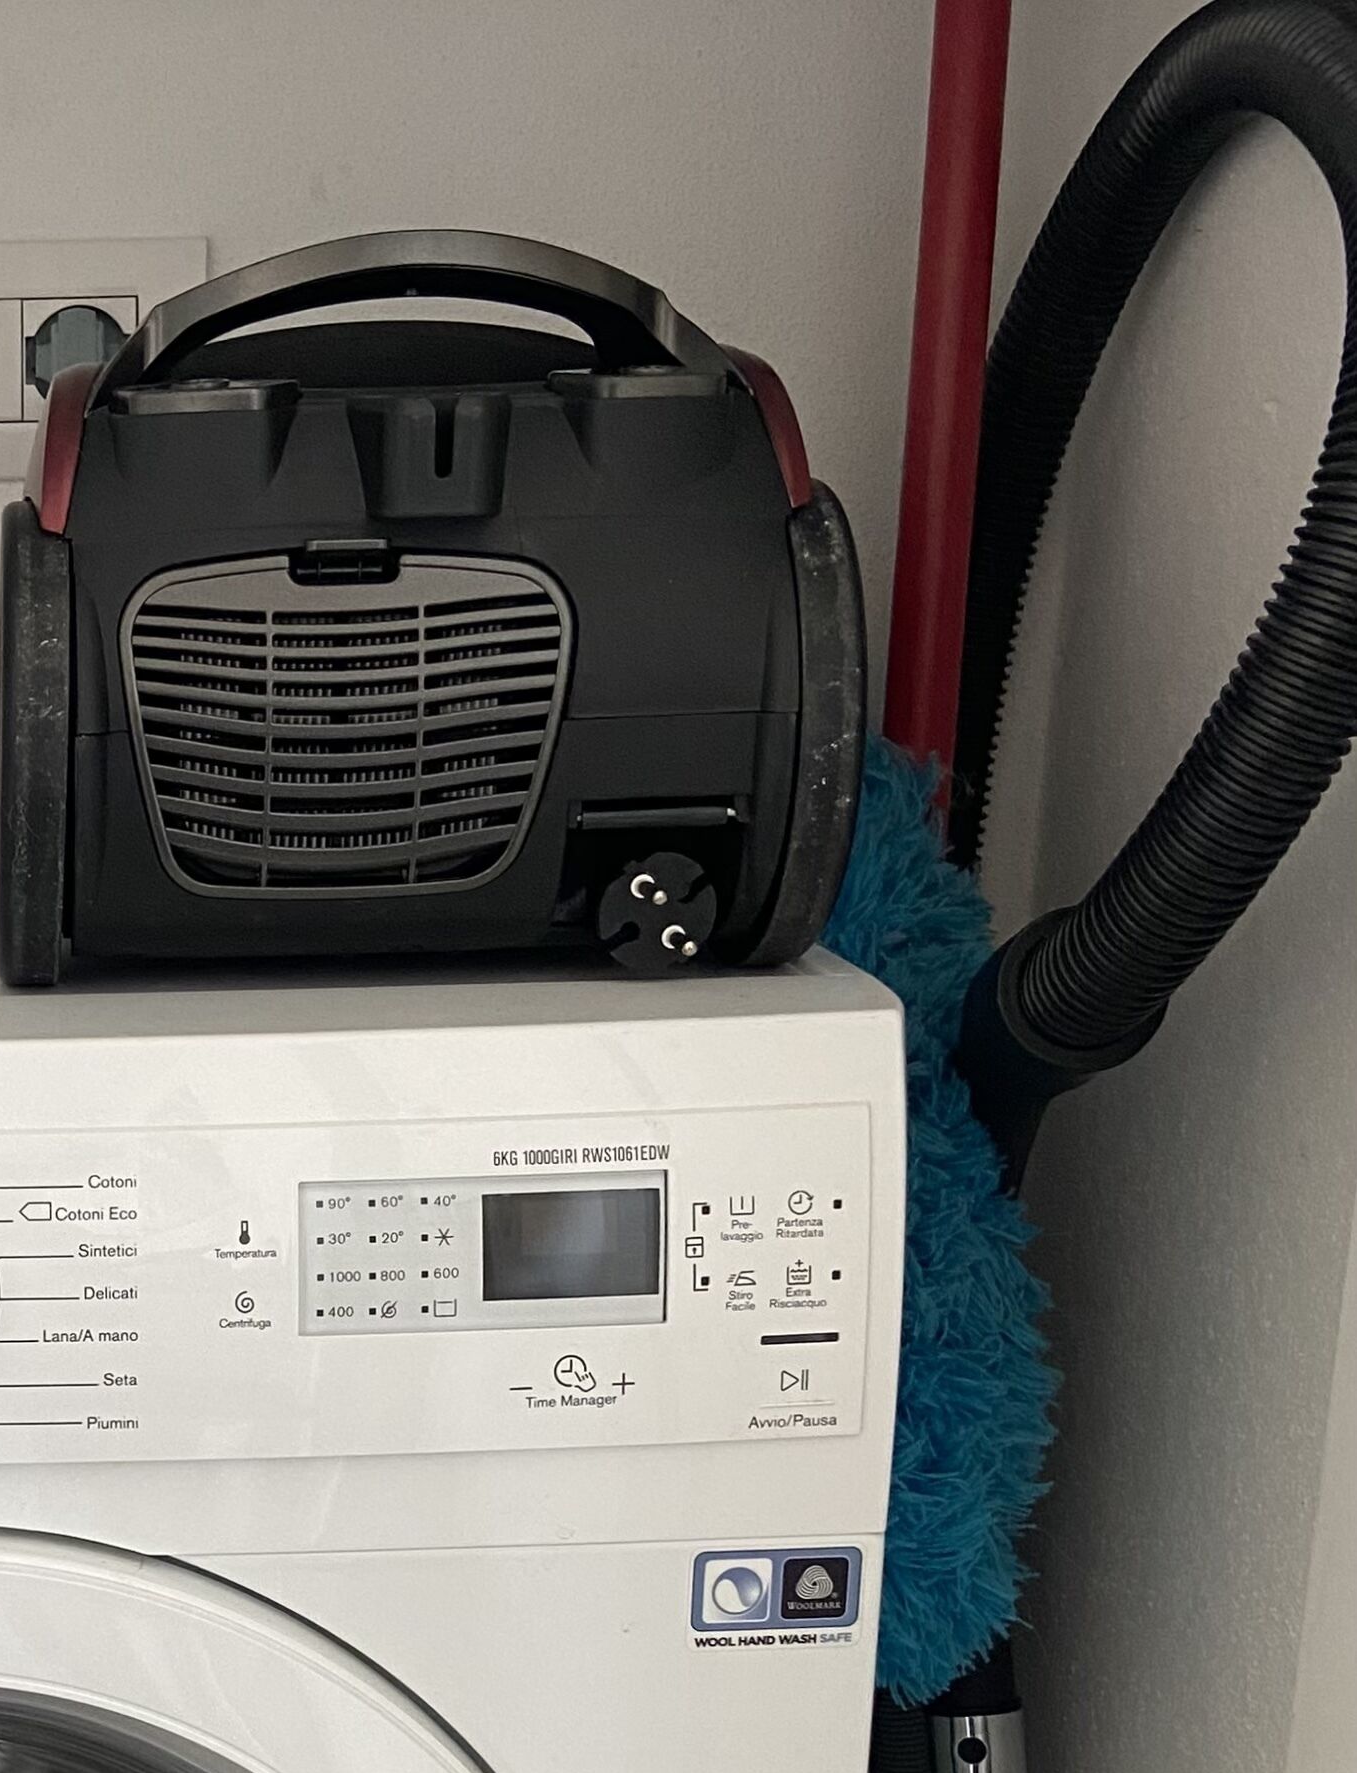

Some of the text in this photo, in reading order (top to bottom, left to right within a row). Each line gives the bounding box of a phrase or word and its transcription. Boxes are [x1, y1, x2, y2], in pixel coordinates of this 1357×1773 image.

[494, 1145, 670, 1166] 6KG 1000GIRI RWS1061EDW
[88, 1175, 137, 1188] Cotoni
[55, 1207, 137, 1221] Cotoni Eco
[731, 1220, 752, 1229] Pre-
[777, 1218, 823, 1227] Partenza
[328, 1231, 403, 1244] 30° 20°
[721, 1232, 763, 1242] lavaggio
[776, 1229, 824, 1238] Ritardata
[78, 1244, 137, 1257] Sintetici
[215, 1249, 277, 1259] Temperatura
[331, 1267, 459, 1282] 1000 800 600
[84, 1287, 137, 1299] Delicati
[729, 1291, 753, 1300] Stiro
[786, 1287, 811, 1297] Extra
[726, 1302, 755, 1311] Facile
[769, 1299, 827, 1308] Risciacquo
[328, 1306, 354, 1317] 400
[219, 1318, 271, 1330] Centrifuga
[43, 1329, 138, 1342] Lana/A mano
[103, 1373, 137, 1386] Seta
[526, 1395, 617, 1409] Time Manager
[87, 1417, 138, 1429] Piumini
[748, 1414, 837, 1428] Avvio/Pausa
[695, 1633, 852, 1647] WOOL HAND WASH SAFE
